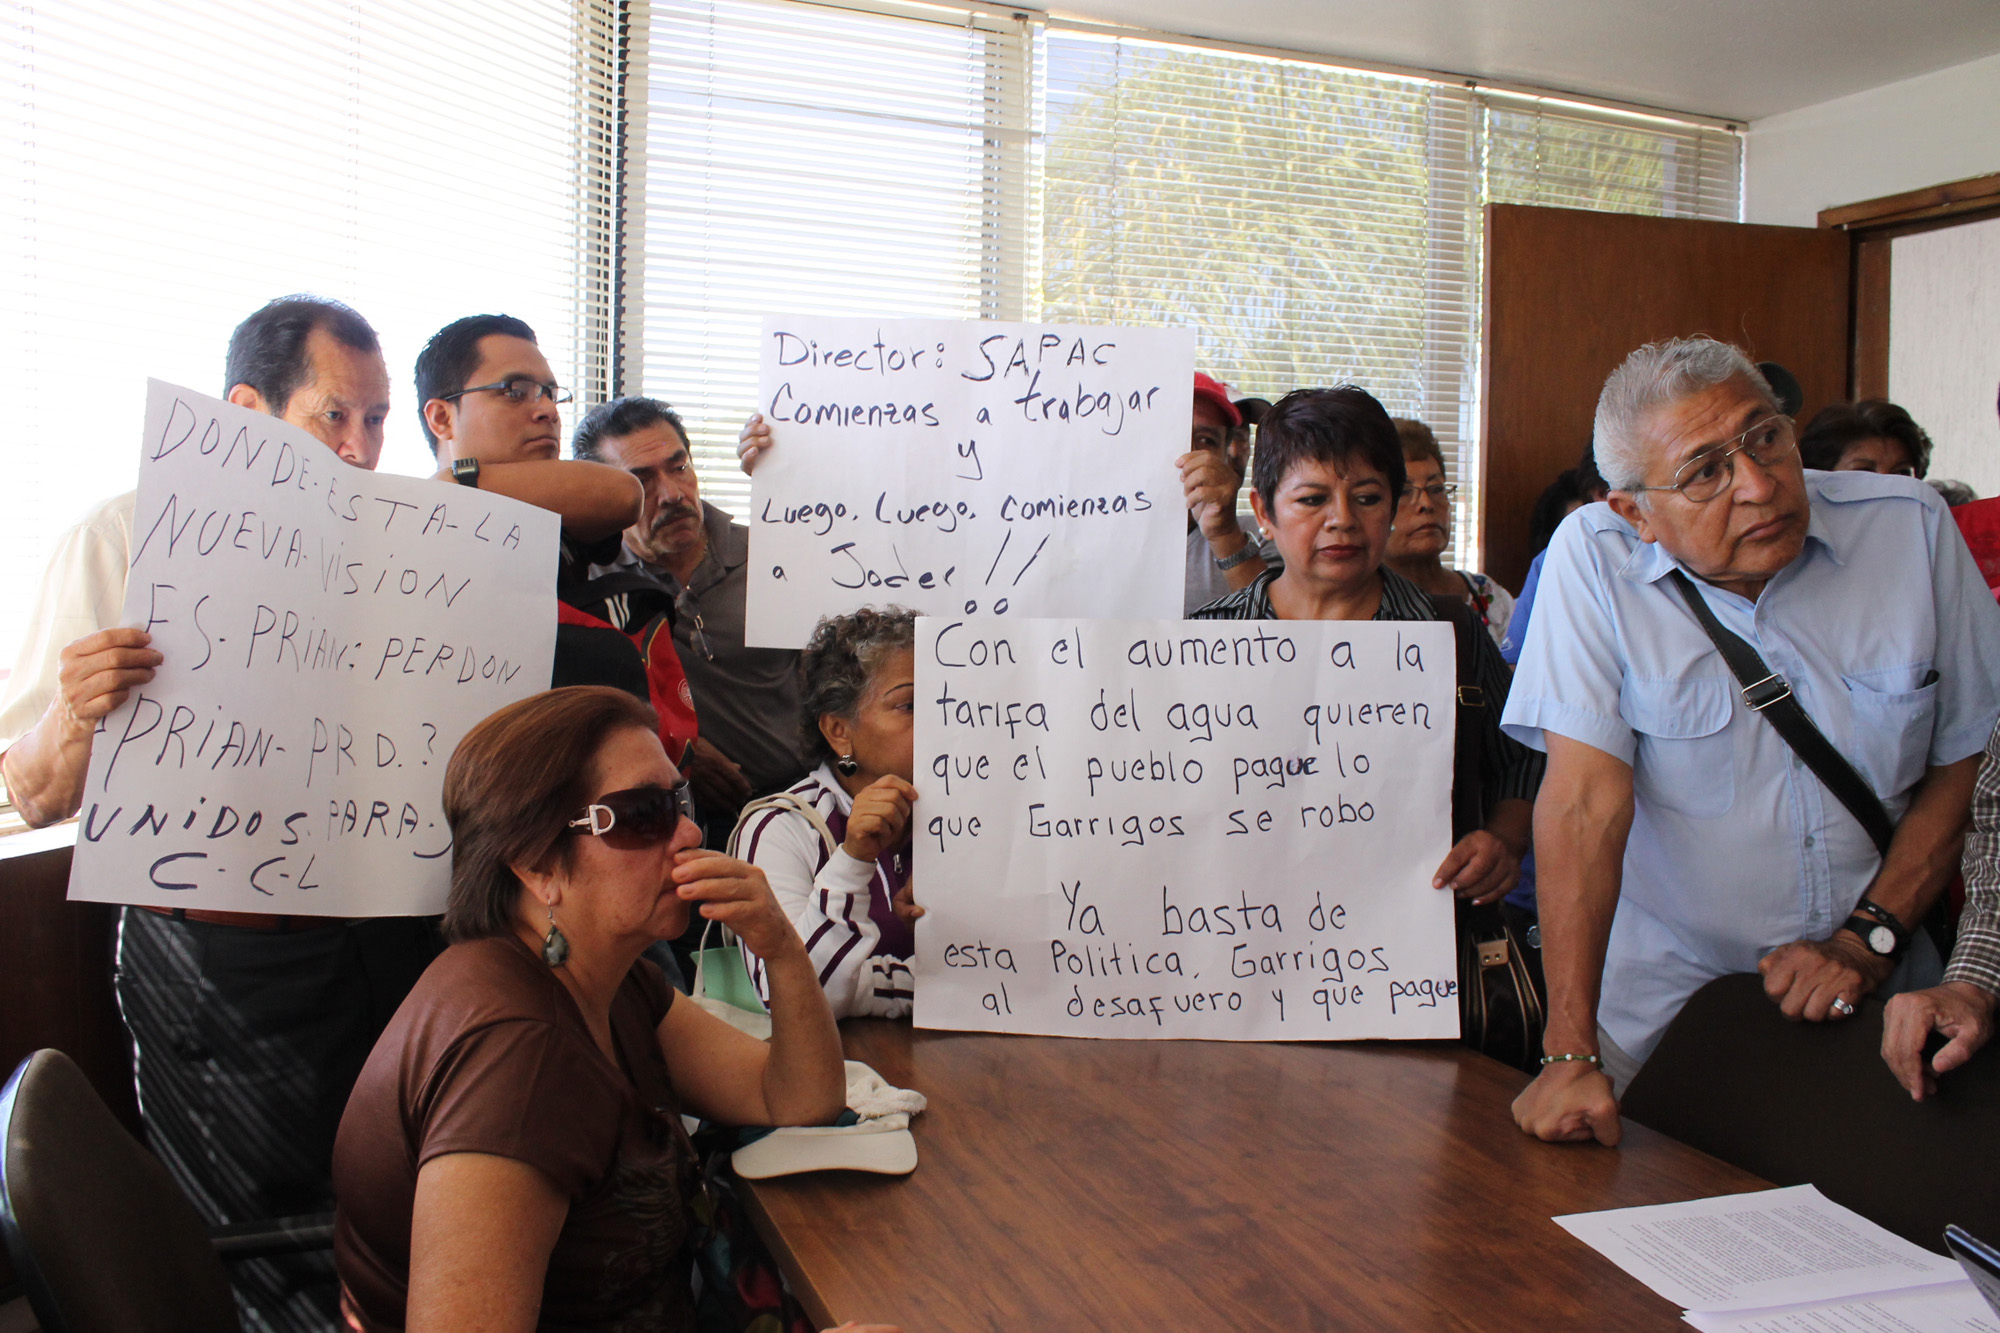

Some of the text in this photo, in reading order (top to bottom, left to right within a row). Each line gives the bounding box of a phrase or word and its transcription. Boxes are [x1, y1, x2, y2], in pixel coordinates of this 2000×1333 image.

[773, 328, 1117, 381] Director: SAPAC
[976, 407, 992, 425] a
[1014, 369, 1160, 435] trabajar
[956, 439, 983, 481] y
[772, 566, 787, 581] a
[935, 622, 1424, 672] Con el aumento a la
[936, 680, 1431, 744] tarifa del agua quieren
[933, 742, 1370, 797] que el pueblo pague lo
[928, 793, 1374, 853] que Garrigos se robo
[1061, 880, 1346, 936] Ya basta de
[944, 940, 1017, 973] esta
[1232, 941, 1389, 983] Garrigos
[982, 982, 1012, 1015] al
[1067, 984, 1241, 1026] desafuero
[1313, 985, 1363, 1022] que
[1390, 979, 1457, 1015] pague
